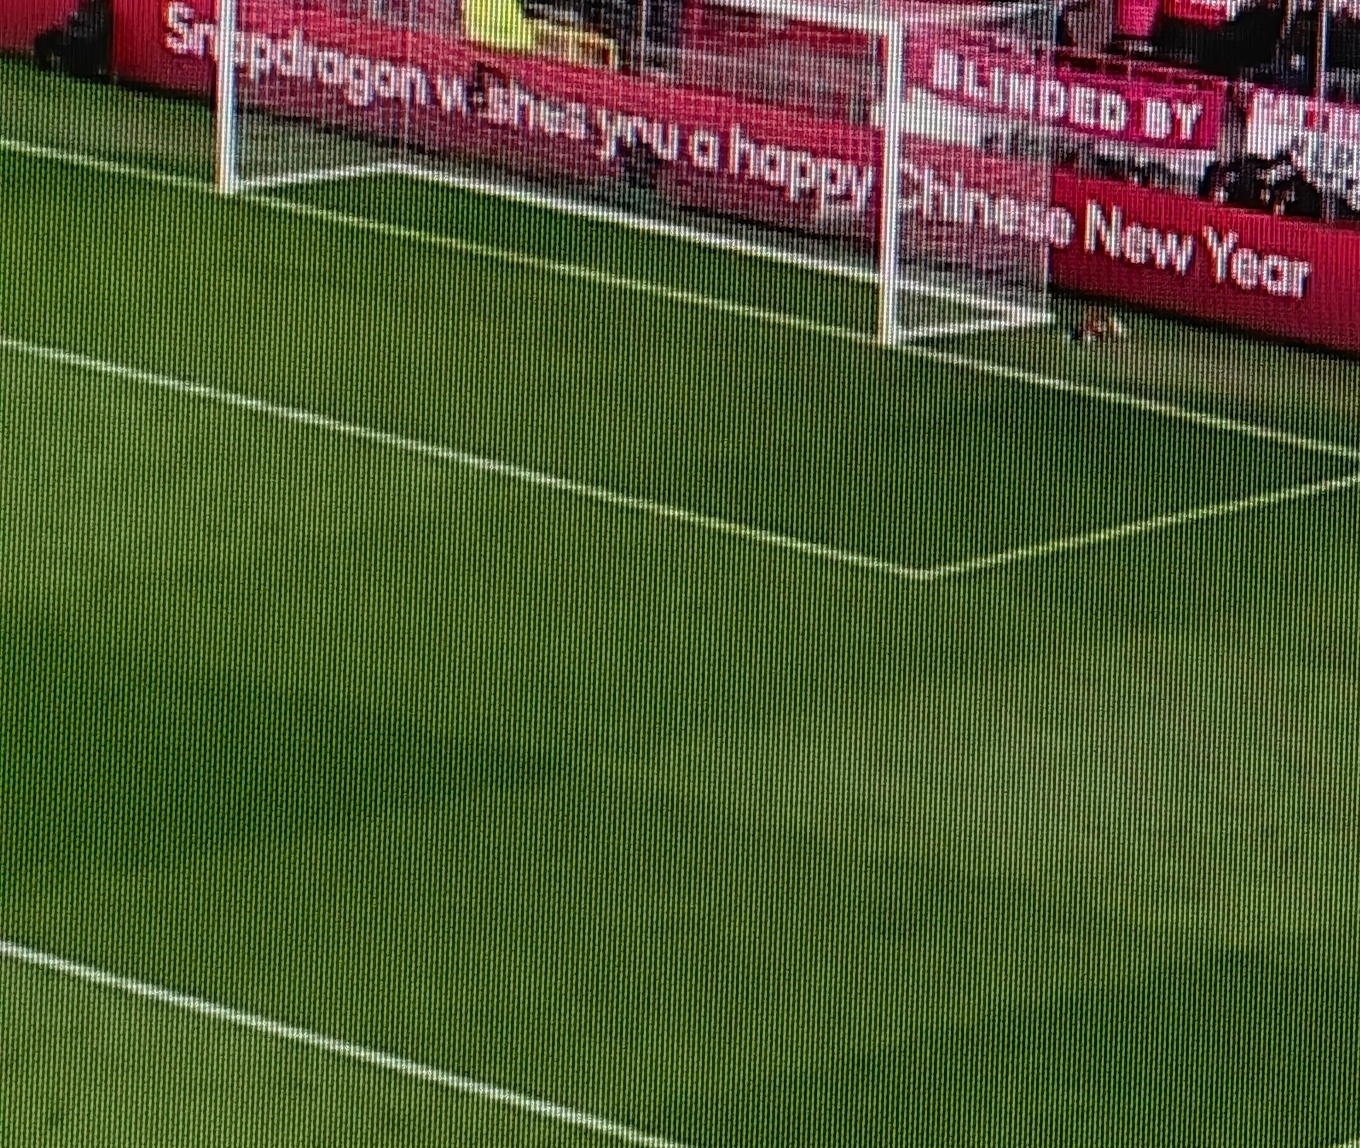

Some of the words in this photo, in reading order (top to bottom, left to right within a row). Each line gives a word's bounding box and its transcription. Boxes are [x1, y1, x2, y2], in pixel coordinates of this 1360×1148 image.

[931, 50, 1128, 130] BLINDED
[1143, 92, 1203, 141] BY
[436, 66, 586, 140] wshes
[689, 127, 720, 169] a
[730, 124, 877, 211] happy
[897, 160, 1074, 248] Chinese
[1084, 200, 1194, 275] New
[1203, 226, 1313, 299] Year
